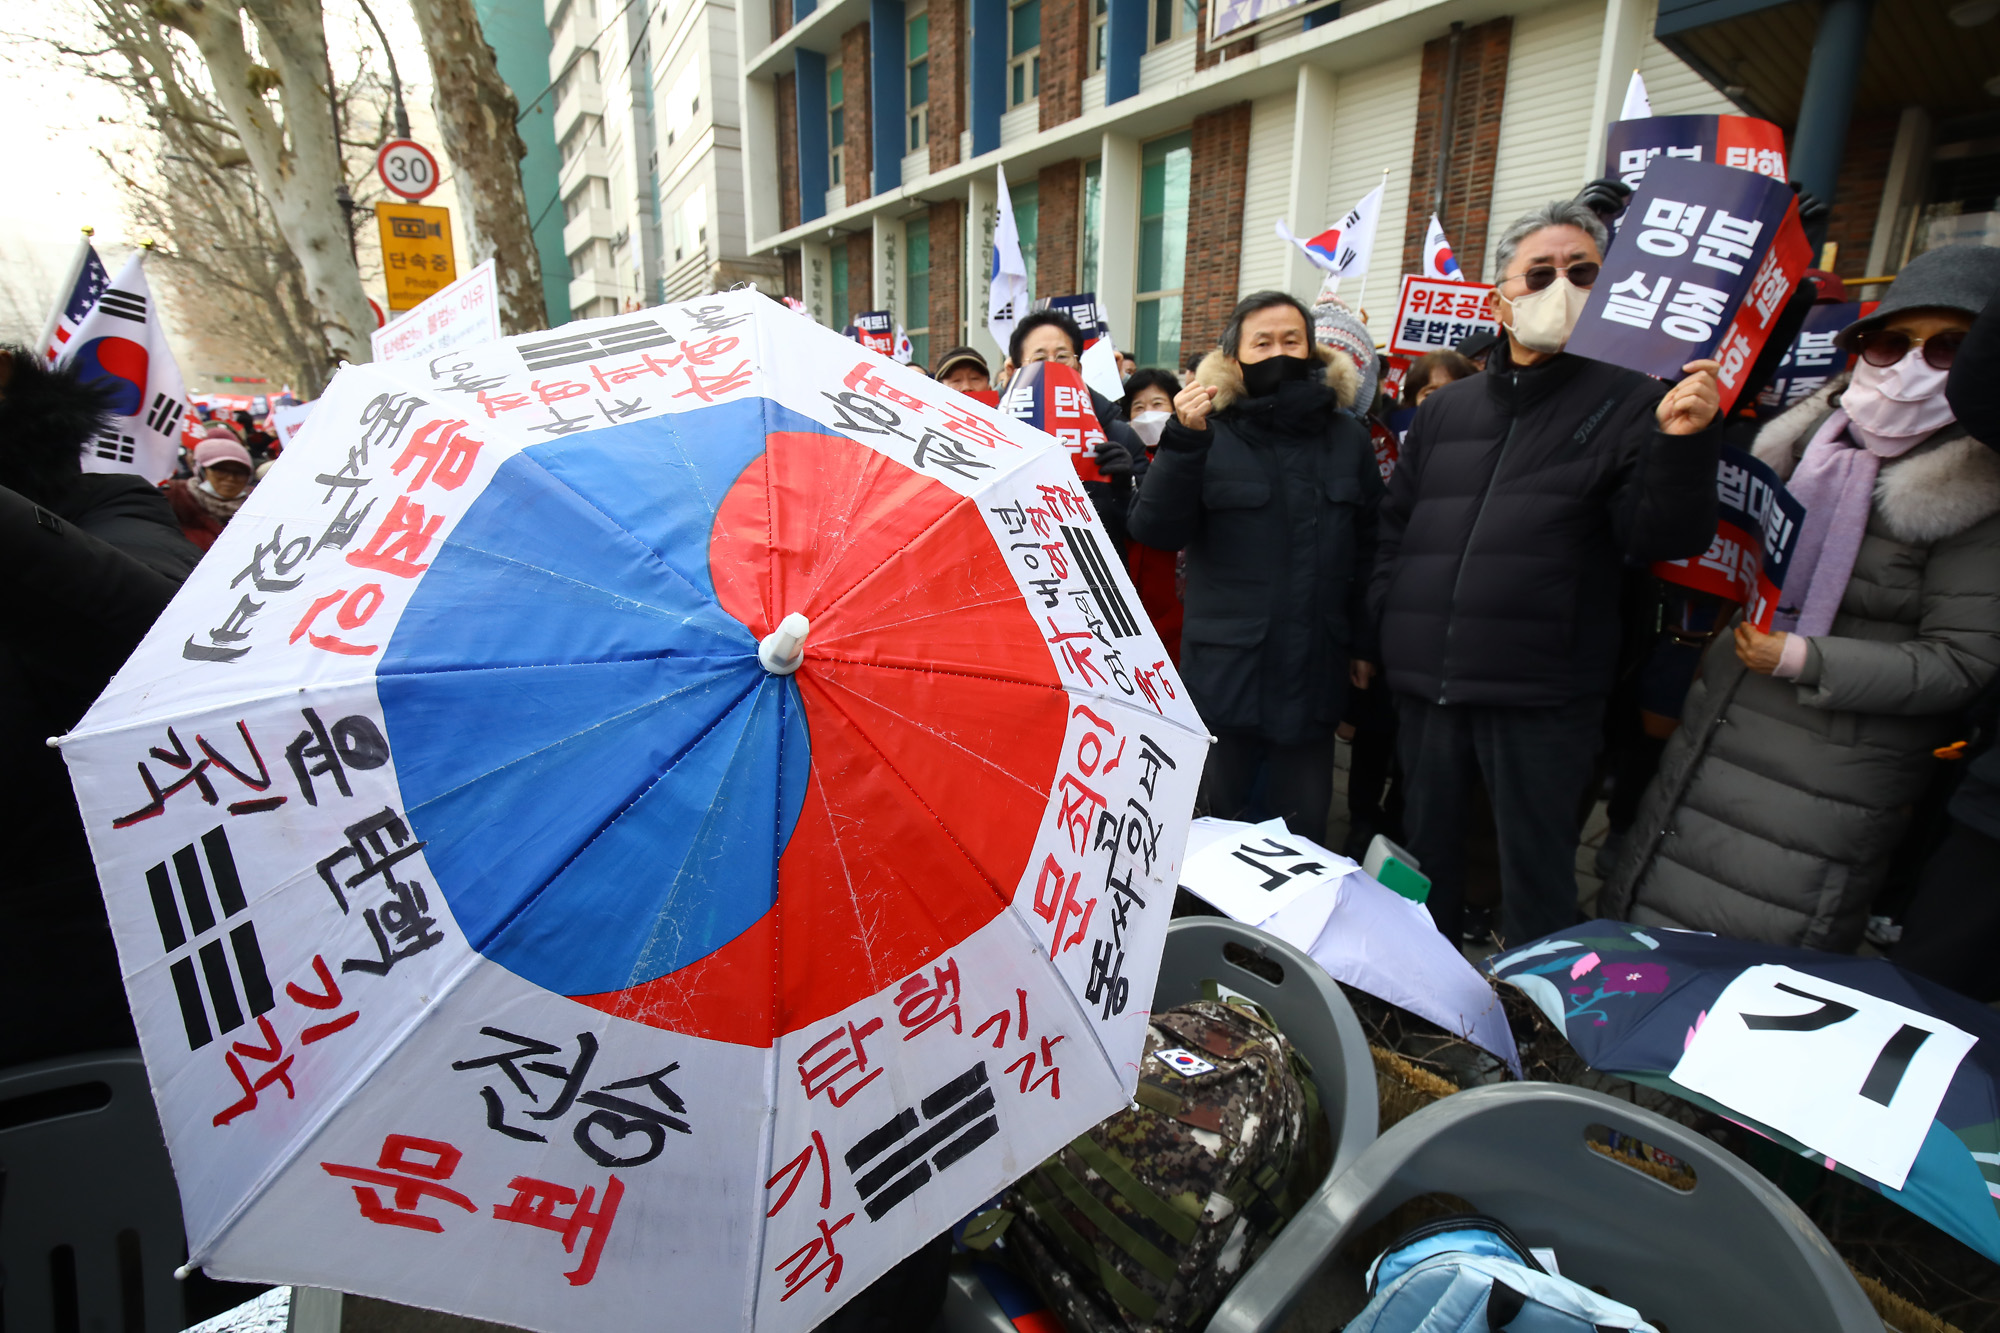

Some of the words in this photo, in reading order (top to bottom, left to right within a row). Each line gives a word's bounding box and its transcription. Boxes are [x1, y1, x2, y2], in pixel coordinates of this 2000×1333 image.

[390, 156, 427, 184] 30
[1619, 145, 1702, 191] 명
[389, 252, 449, 272] 단속중
[405, 276, 439, 289] Photo
[1636, 197, 1763, 276] 명분
[461, 285, 485, 310] 이유
[1601, 270, 1730, 343] 실종
[112, 719, 288, 829] 기각
[285, 707, 390, 807] 윤
[1033, 704, 1126, 962] 문죄인
[1231, 838, 1328, 892] 각
[315, 805, 445, 977] 탄핵
[213, 954, 360, 1128] 기각
[797, 956, 964, 1108] 탄핵
[972, 988, 1065, 1100] 기각
[1738, 982, 1935, 1108] 기
[452, 1026, 692, 1168] 전승
[320, 1133, 626, 1287] 문패
[765, 1130, 855, 1302] 기각
